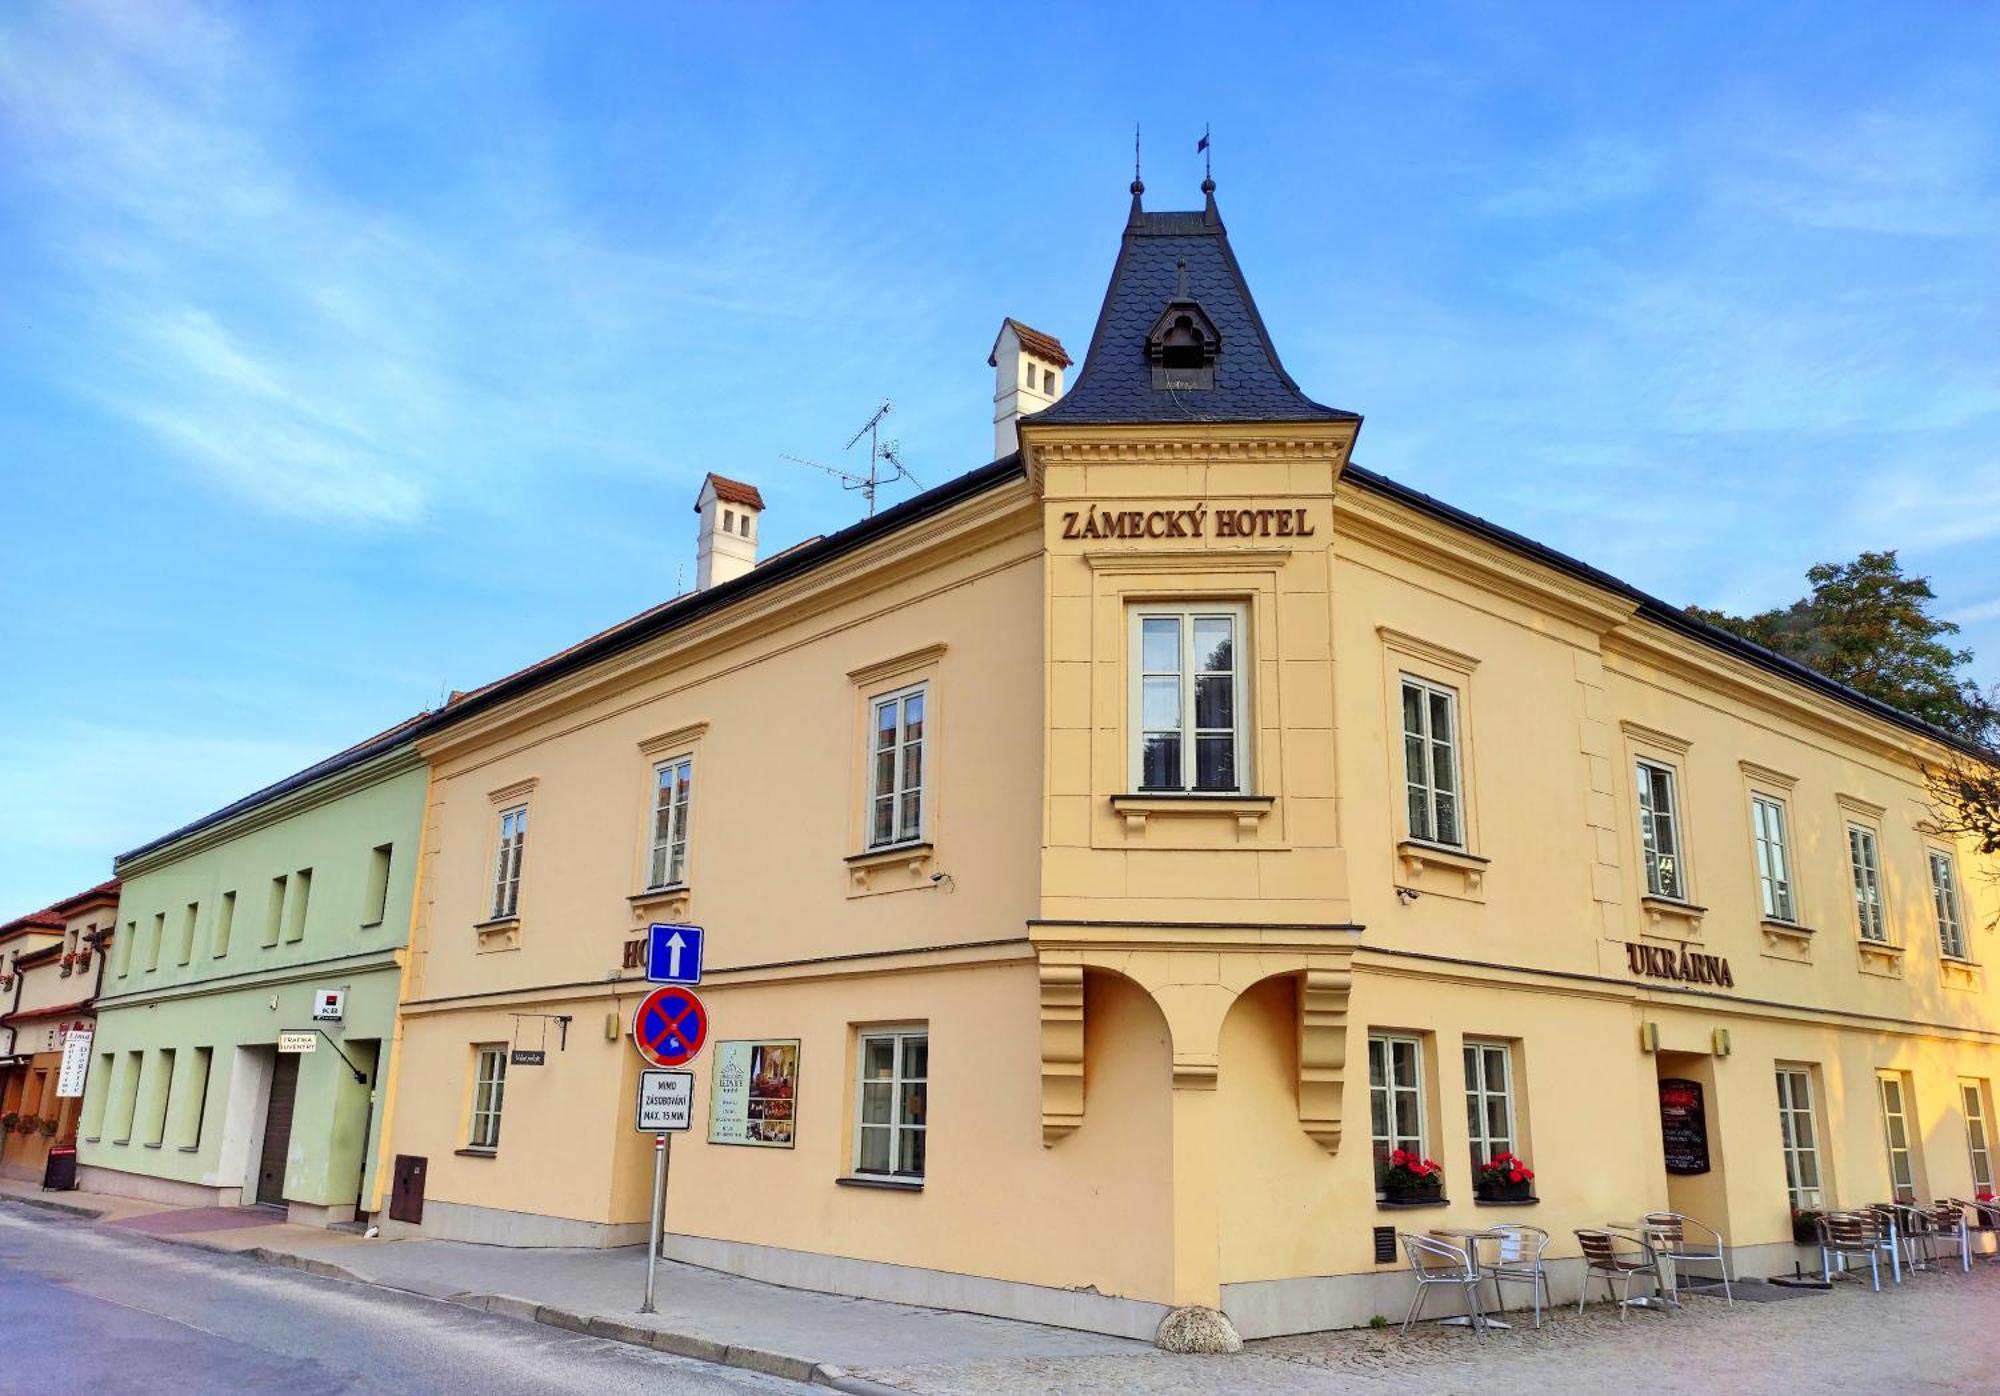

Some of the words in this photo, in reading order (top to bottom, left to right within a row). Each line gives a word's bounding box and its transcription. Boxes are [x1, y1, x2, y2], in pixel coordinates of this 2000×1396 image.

[1062, 503, 1207, 540] ZÁMECKÝ
[1215, 508, 1316, 538] HOTEL
[1624, 941, 1735, 988] UKRÁRNA
[657, 1081, 677, 1090] MIMO
[646, 1094, 687, 1106] ZÁSOBOVÁNÍ
[643, 1111, 661, 1121] MAX.
[662, 1111, 670, 1121] 15
[671, 1111, 686, 1121] MIN.
